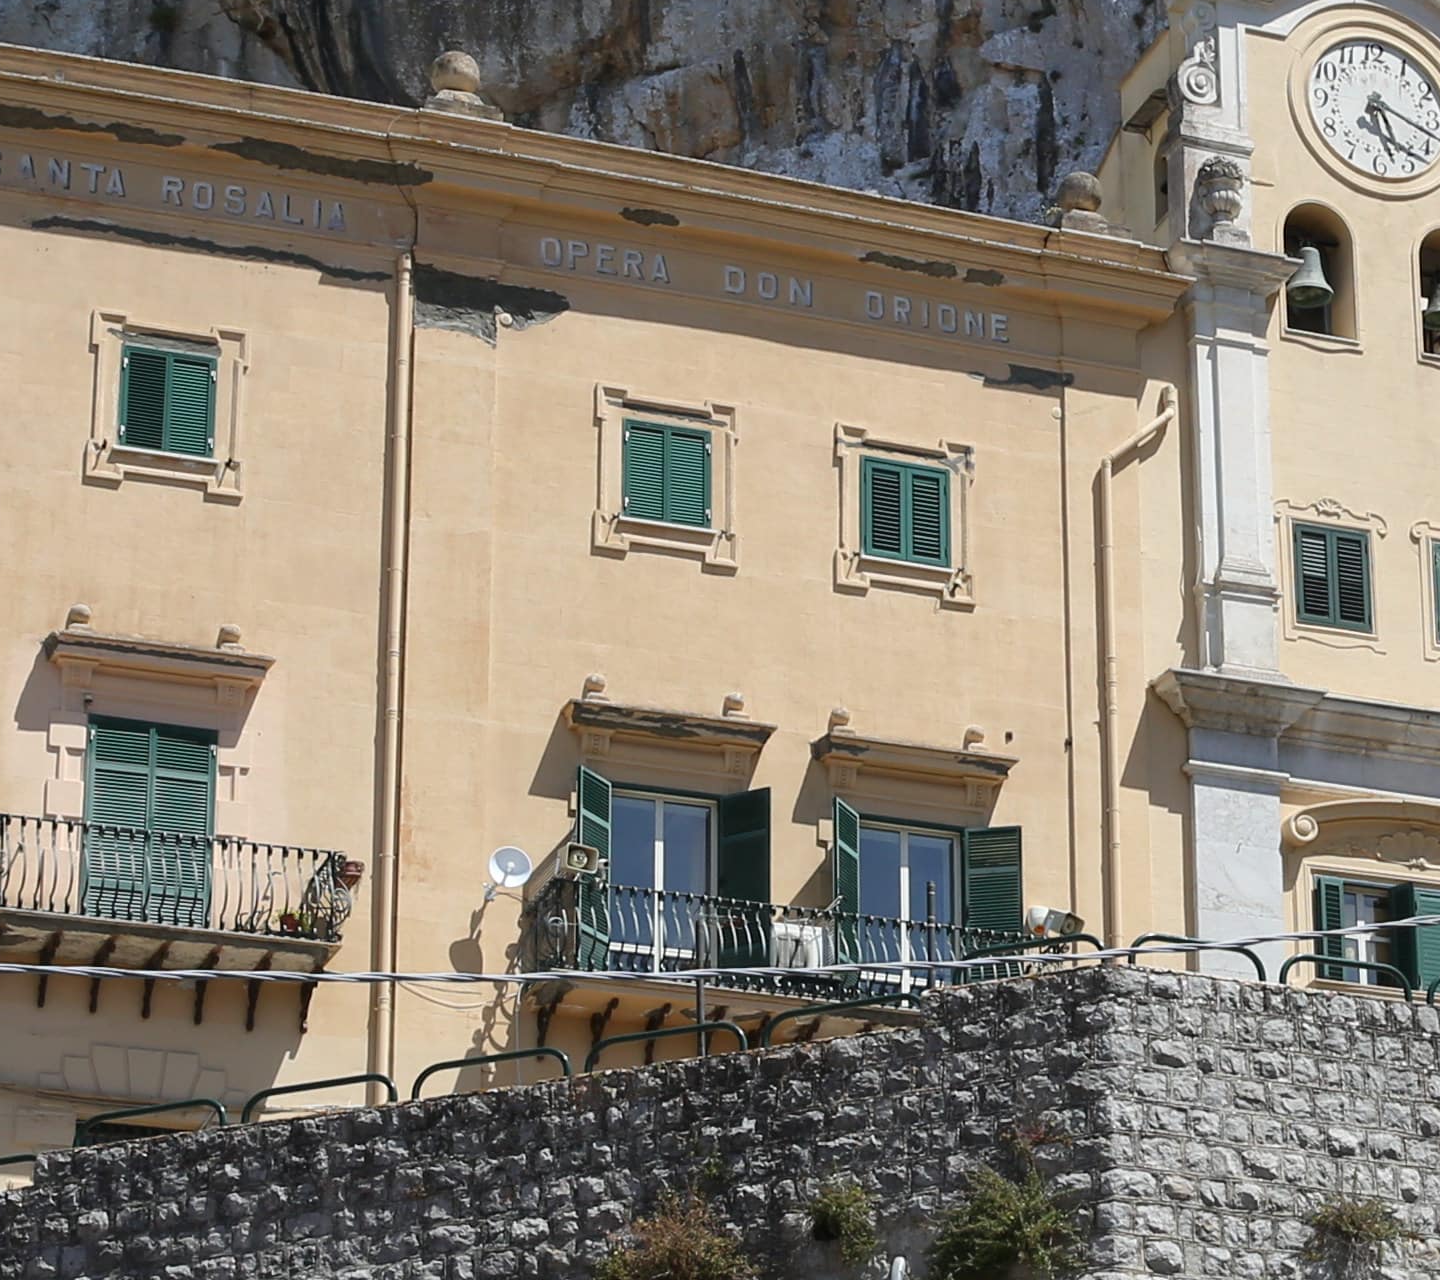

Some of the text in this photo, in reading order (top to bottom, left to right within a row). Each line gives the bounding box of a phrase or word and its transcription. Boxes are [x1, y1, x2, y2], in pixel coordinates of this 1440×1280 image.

[1361, 43, 1384, 64] 12
[1313, 87, 1329, 109] 9
[1417, 80, 1433, 101] 2
[1322, 116, 1337, 138] 8
[1425, 109, 1440, 131] 3
[1345, 138, 1357, 160] 7
[1420, 137, 1436, 156] 4
[1372, 153, 1388, 176] 6
[161, 175, 347, 232] ROSALIA
[540, 236, 1010, 344] OPERA DON ORIONE
